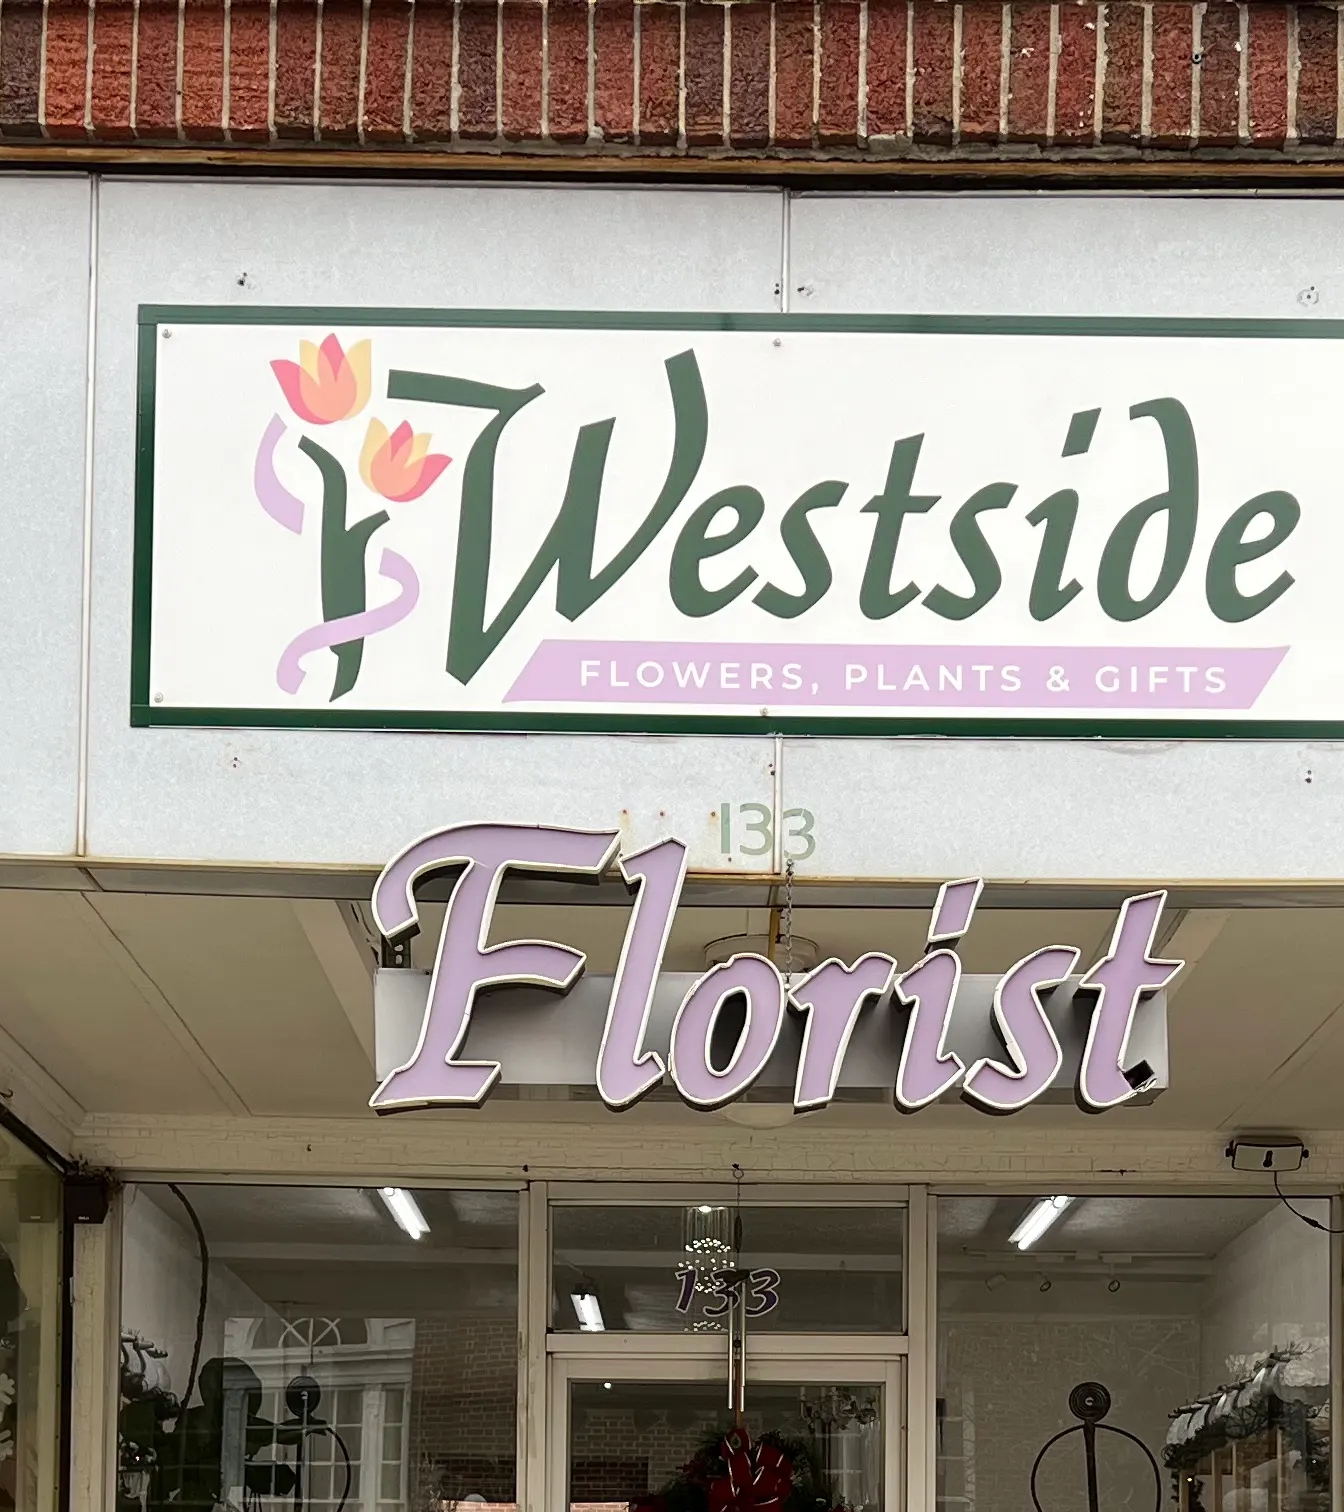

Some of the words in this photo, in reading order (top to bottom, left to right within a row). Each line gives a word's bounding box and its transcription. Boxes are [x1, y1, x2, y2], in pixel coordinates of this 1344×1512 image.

[388, 350, 1301, 686] Westside
[579, 660, 819, 696] FLOWERS,
[845, 663, 1021, 692] PLANTS
[1047, 665, 1070, 692] &
[1095, 665, 1228, 694] GIFTS
[719, 801, 816, 861] 133
[369, 820, 1185, 1112] Florist
[674, 1268, 781, 1317] 133
